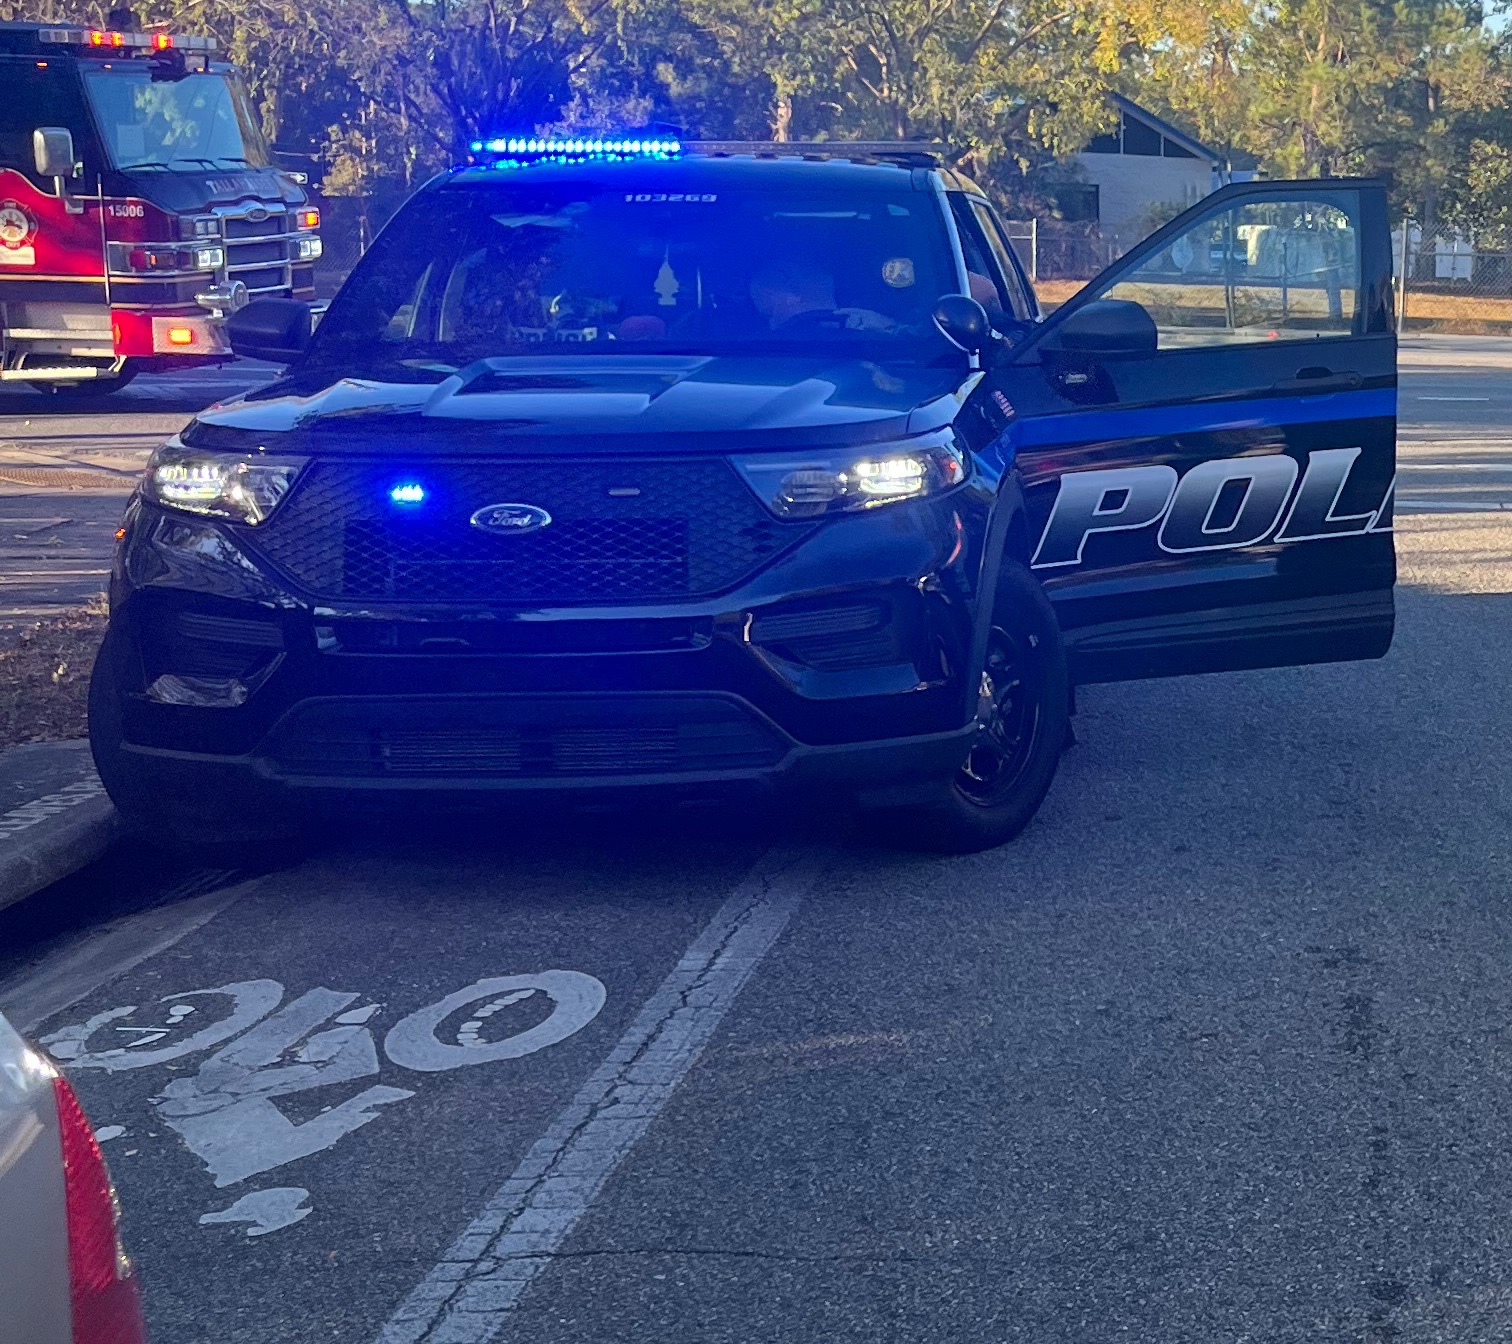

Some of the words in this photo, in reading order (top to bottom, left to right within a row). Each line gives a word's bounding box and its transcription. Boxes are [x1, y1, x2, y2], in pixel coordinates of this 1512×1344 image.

[108, 204, 145, 217] 15006
[488, 508, 533, 527] Ford
[1031, 447, 1396, 570] POL
